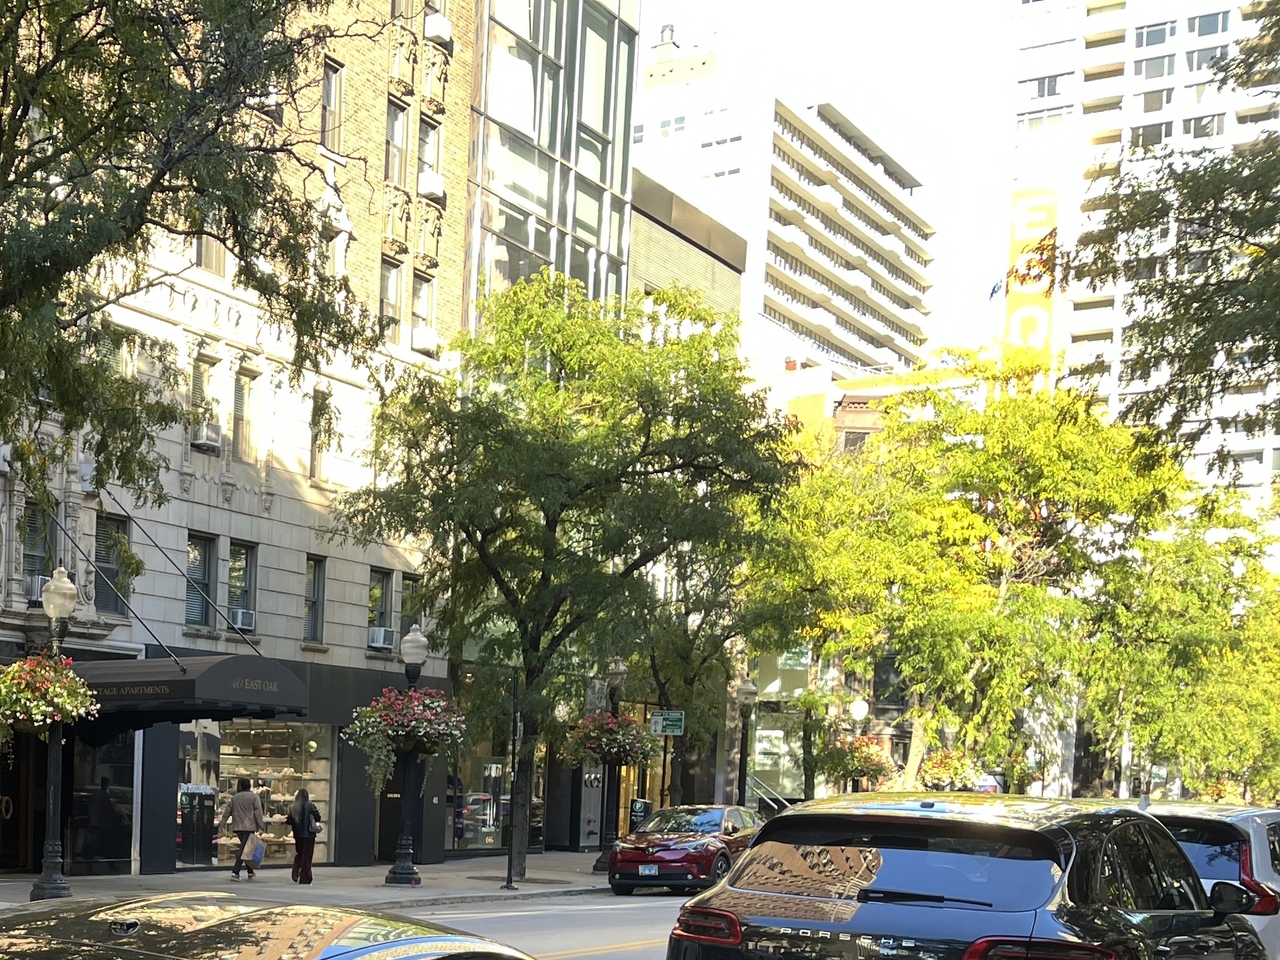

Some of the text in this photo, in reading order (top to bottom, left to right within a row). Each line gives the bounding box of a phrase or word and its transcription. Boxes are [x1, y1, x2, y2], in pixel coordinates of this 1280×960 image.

[119, 686, 169, 695] APARTMENTS
[245, 679, 262, 690] EAST
[263, 681, 279, 692] OAK
[780, 927, 916, 947] PORSCHE
